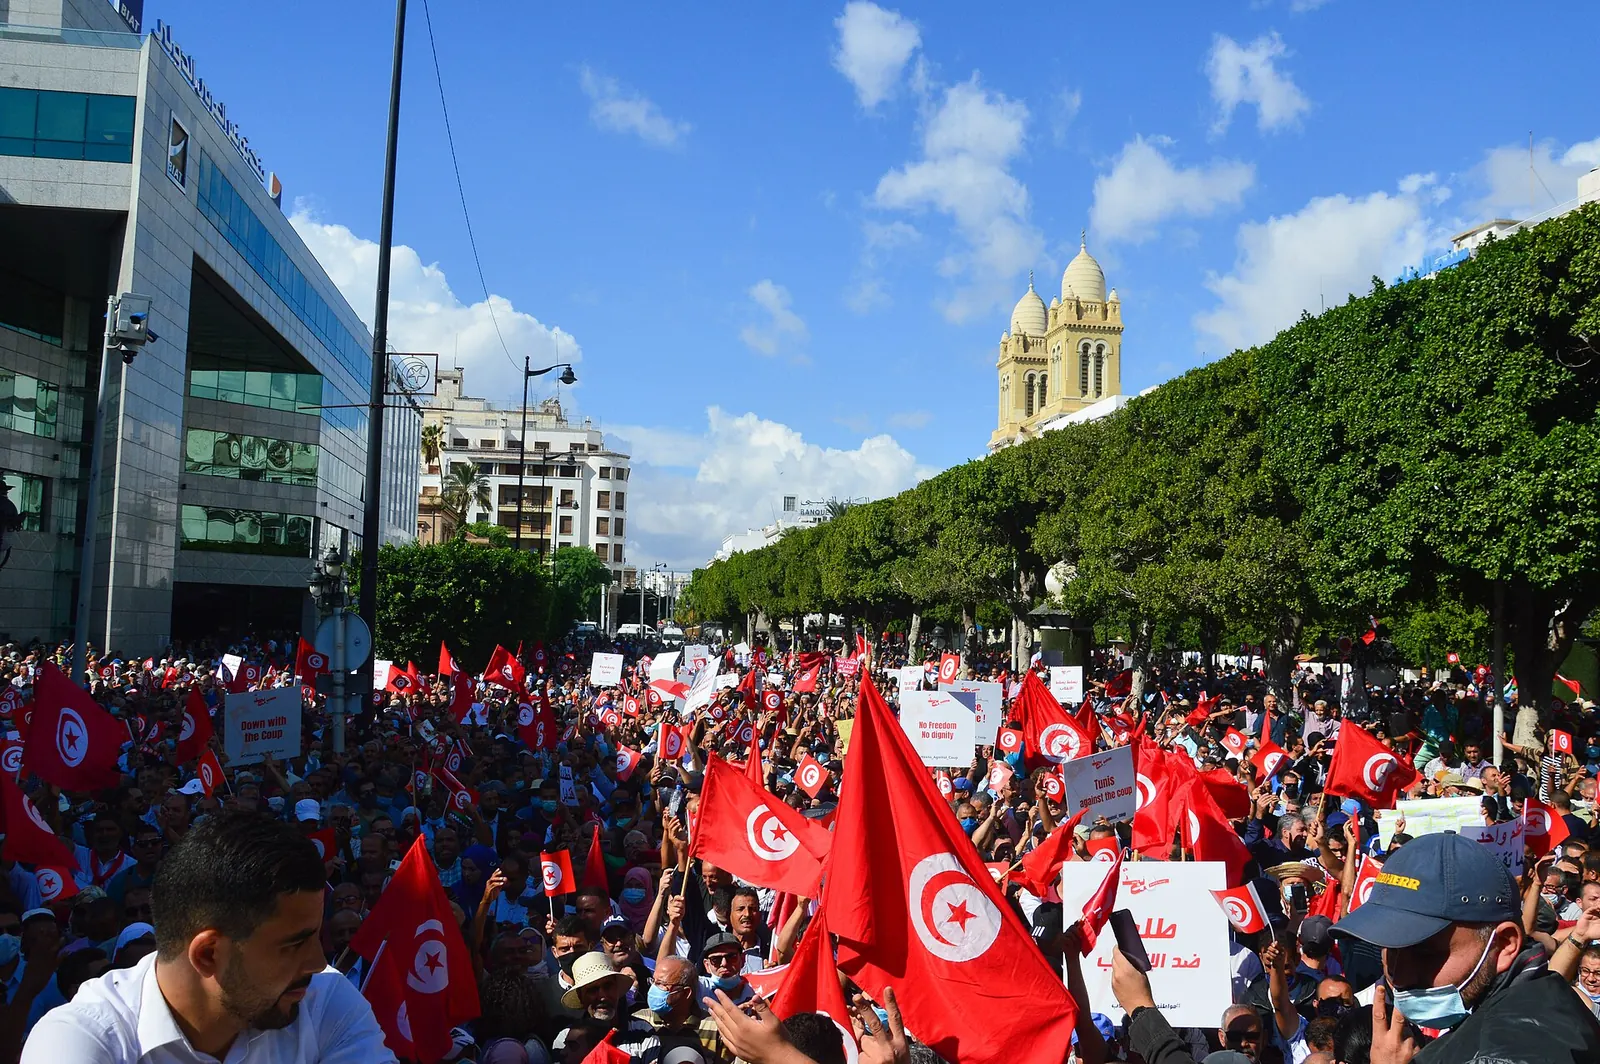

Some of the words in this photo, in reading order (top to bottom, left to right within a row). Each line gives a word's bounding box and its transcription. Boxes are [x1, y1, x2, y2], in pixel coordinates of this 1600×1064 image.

[120, 3, 140, 32] BIAT
[168, 161, 183, 183] BIAT
[241, 719, 265, 731] Down
[268, 716, 287, 728] with
[918, 721, 928, 729] No
[929, 721, 957, 730] Freedom
[245, 732, 259, 743] the
[261, 729, 283, 741] Coup
[921, 731, 930, 739] No
[931, 731, 954, 740] dignity
[1094, 775, 1115, 790] Tunis
[1079, 793, 1104, 808] against
[1105, 791, 1116, 800] the
[1116, 786, 1133, 797] coup
[603, 914, 624, 927] FILA
[1171, 953, 1201, 969] ضد
